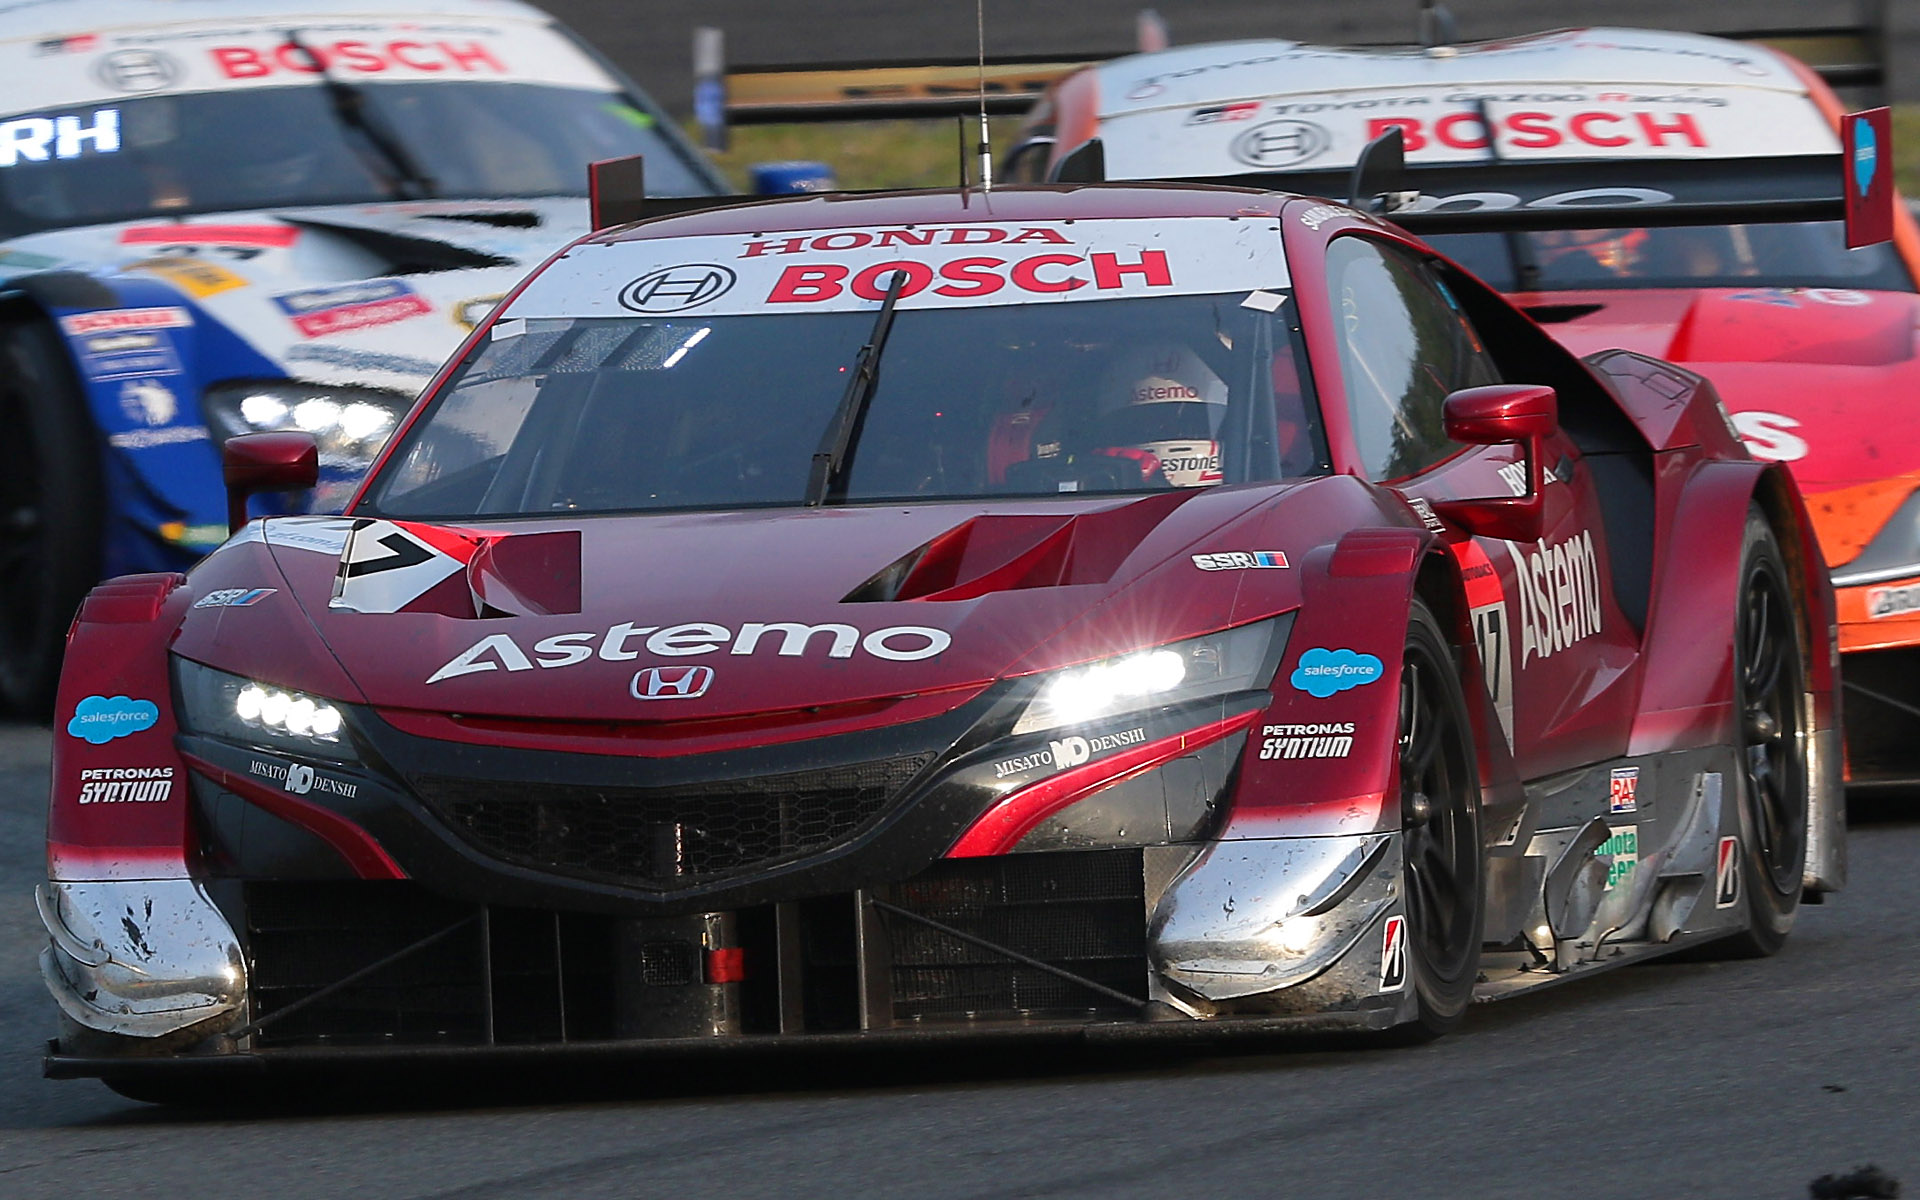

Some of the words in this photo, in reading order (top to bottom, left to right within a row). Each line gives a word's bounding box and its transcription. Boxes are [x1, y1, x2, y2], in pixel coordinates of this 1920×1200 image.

[207, 39, 508, 79] BOSCH
[1367, 111, 1710, 152] BOSCH
[738, 227, 1075, 259] HONDA
[765, 250, 1174, 304] BOSCH
[1504, 529, 1602, 670] Astemo
[426, 622, 952, 684] Astemo
[1304, 664, 1374, 678] salesforce
[1477, 609, 1501, 702] 17
[80, 710, 149, 725] salesforce
[1262, 722, 1355, 736] PETRONAS
[995, 751, 1052, 778] MISATO
[1090, 727, 1146, 752] DENSHI
[1260, 736, 1353, 759] SYNTIUM
[79, 780, 172, 804] SYNTIUM
[81, 767, 173, 781] PETRONAS
[249, 760, 287, 781] MISATO
[313, 776, 358, 798] DENSHI
